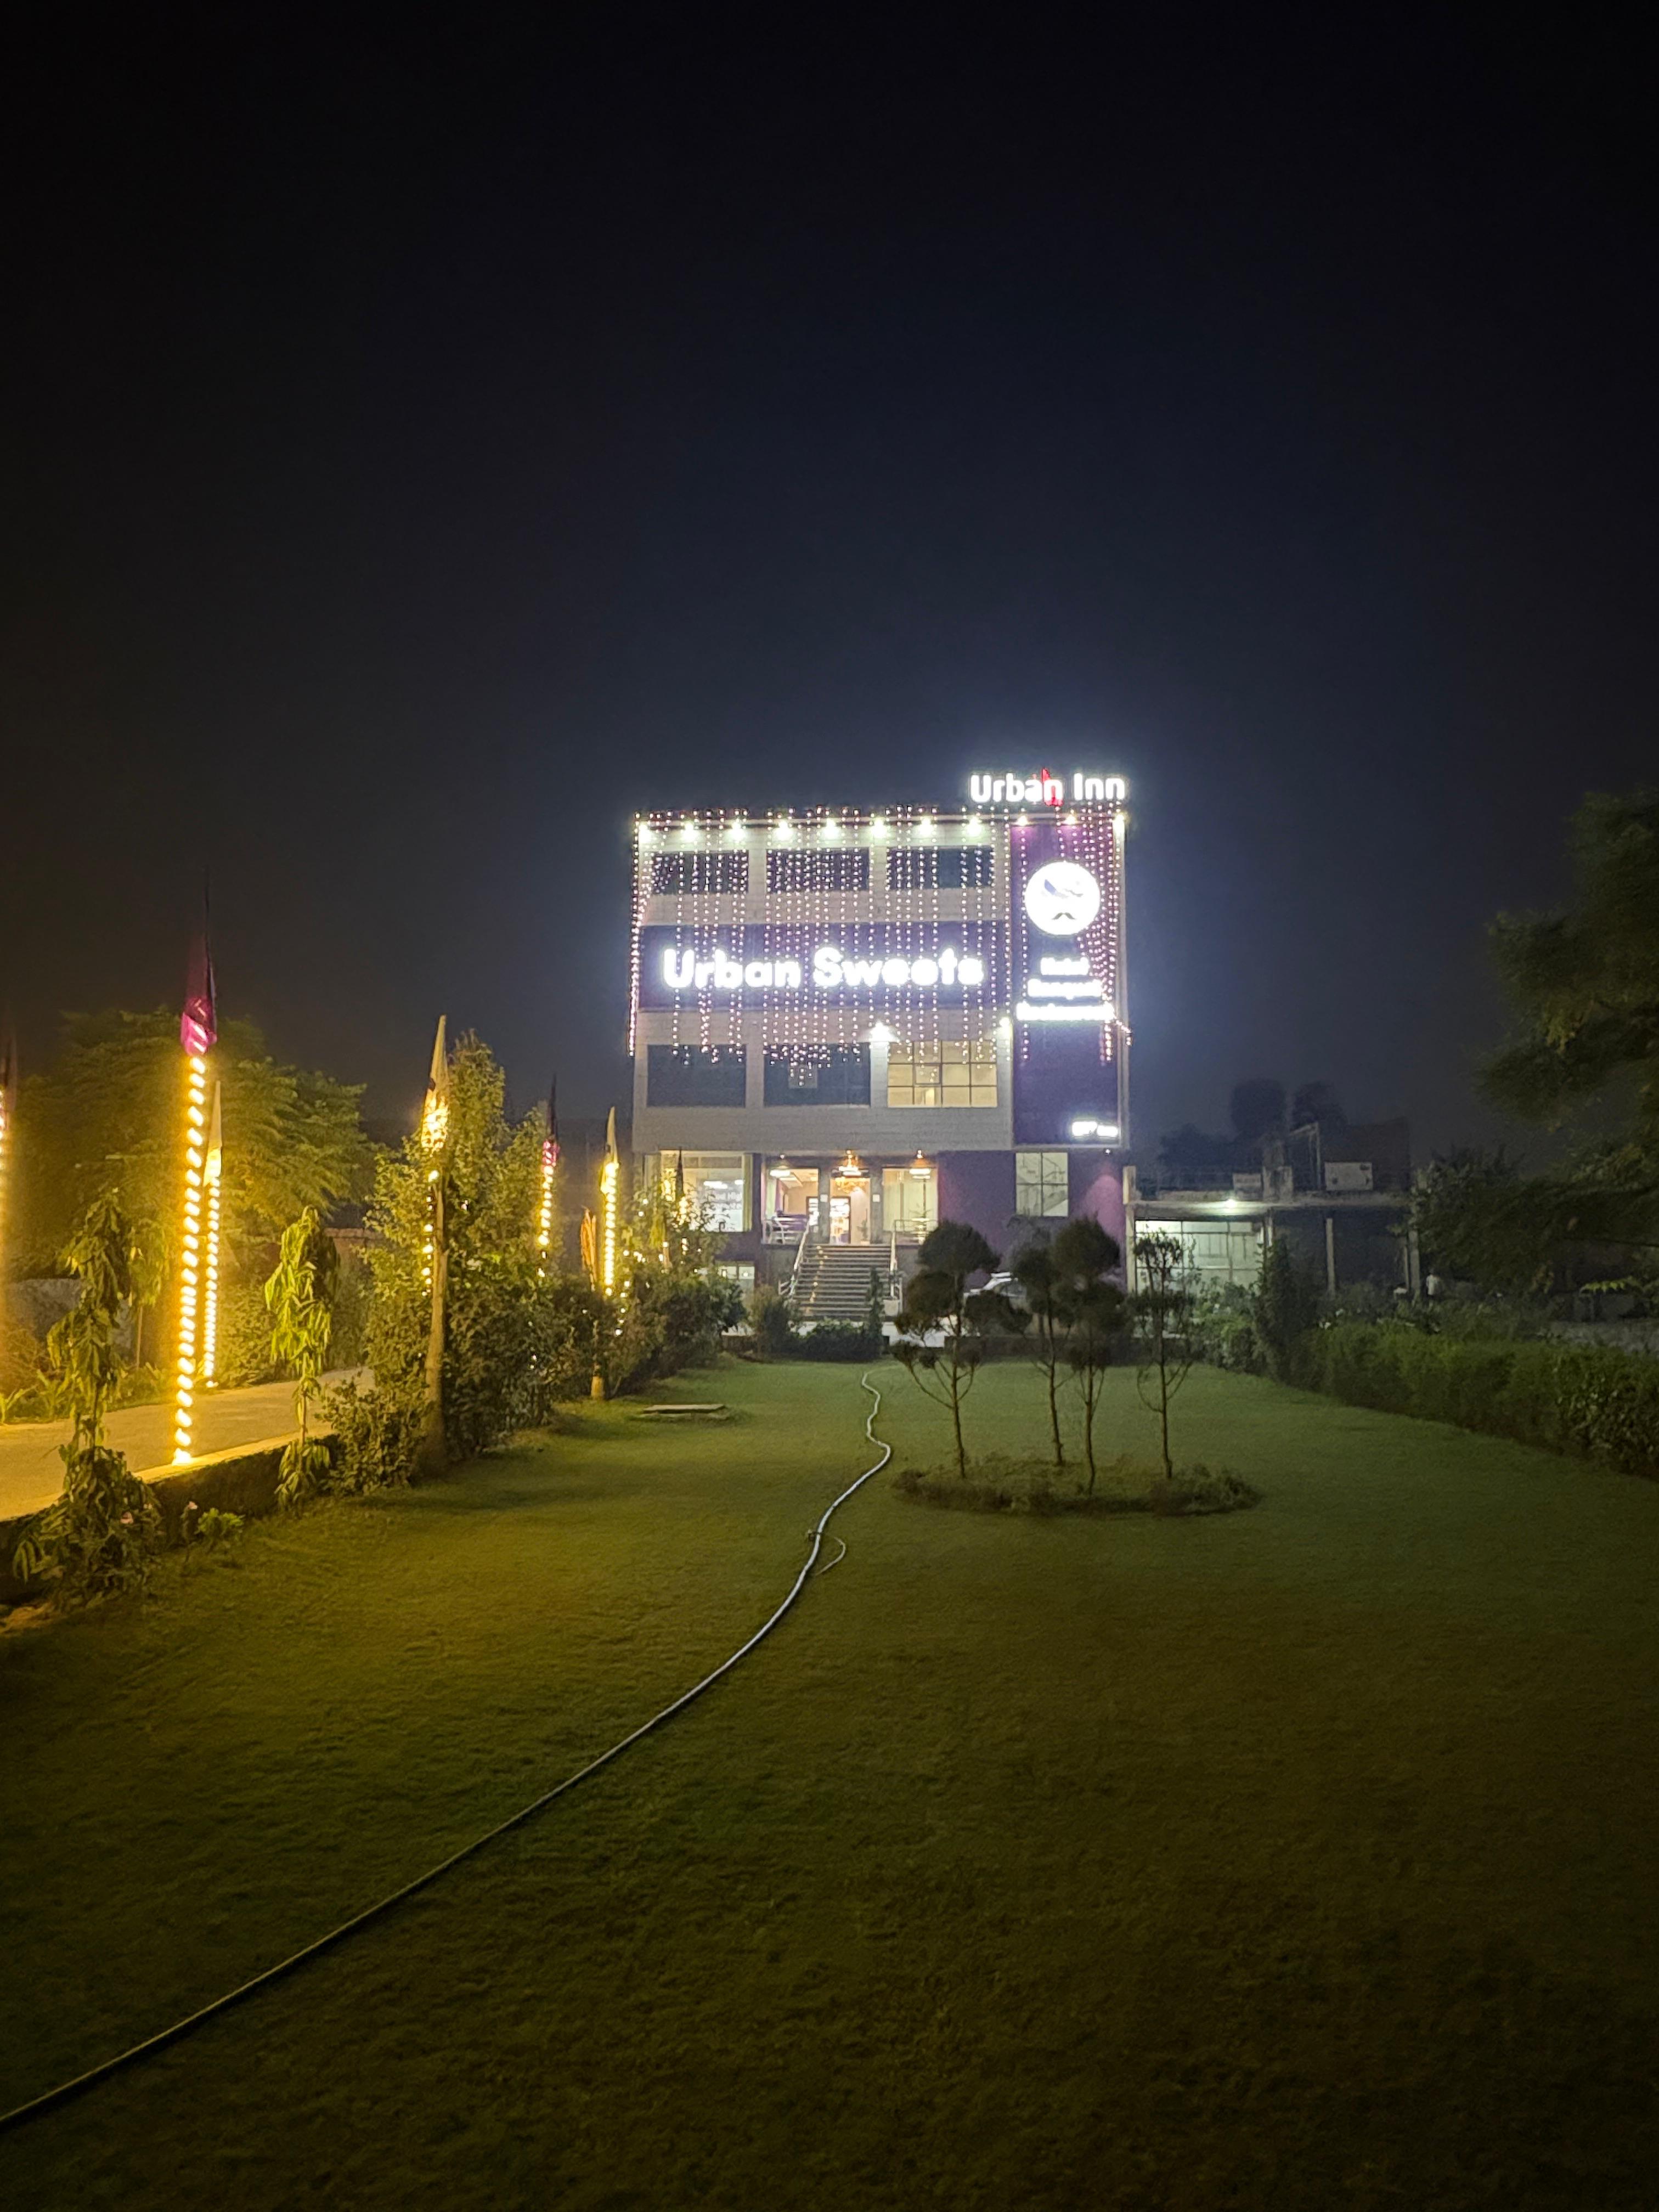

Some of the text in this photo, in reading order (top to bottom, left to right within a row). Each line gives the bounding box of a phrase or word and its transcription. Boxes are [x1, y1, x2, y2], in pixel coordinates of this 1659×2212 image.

[970, 772, 1125, 803] Urban Inn
[663, 946, 984, 989] Urban Sweets
